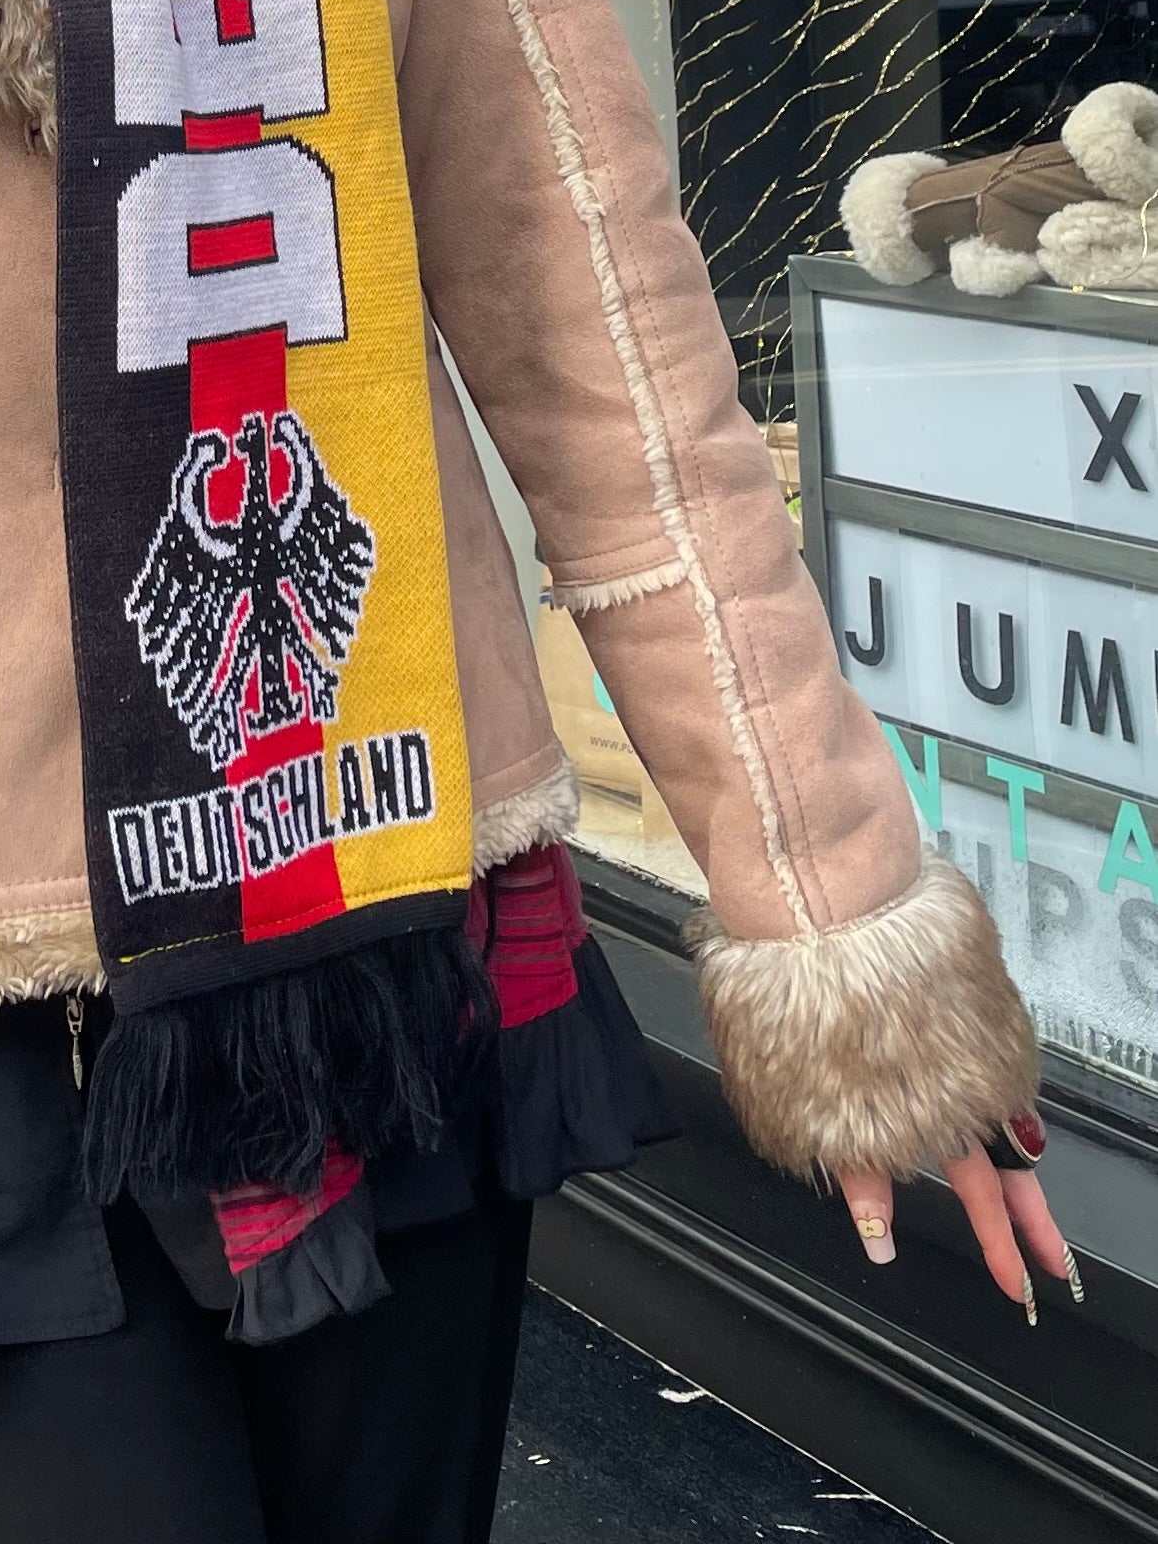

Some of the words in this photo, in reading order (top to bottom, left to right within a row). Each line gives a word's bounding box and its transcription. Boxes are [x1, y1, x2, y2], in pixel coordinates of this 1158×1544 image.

[1073, 384, 1148, 492] X
[844, 575, 1158, 745] JUM
[109, 729, 437, 905] DEUTSCHLAND
